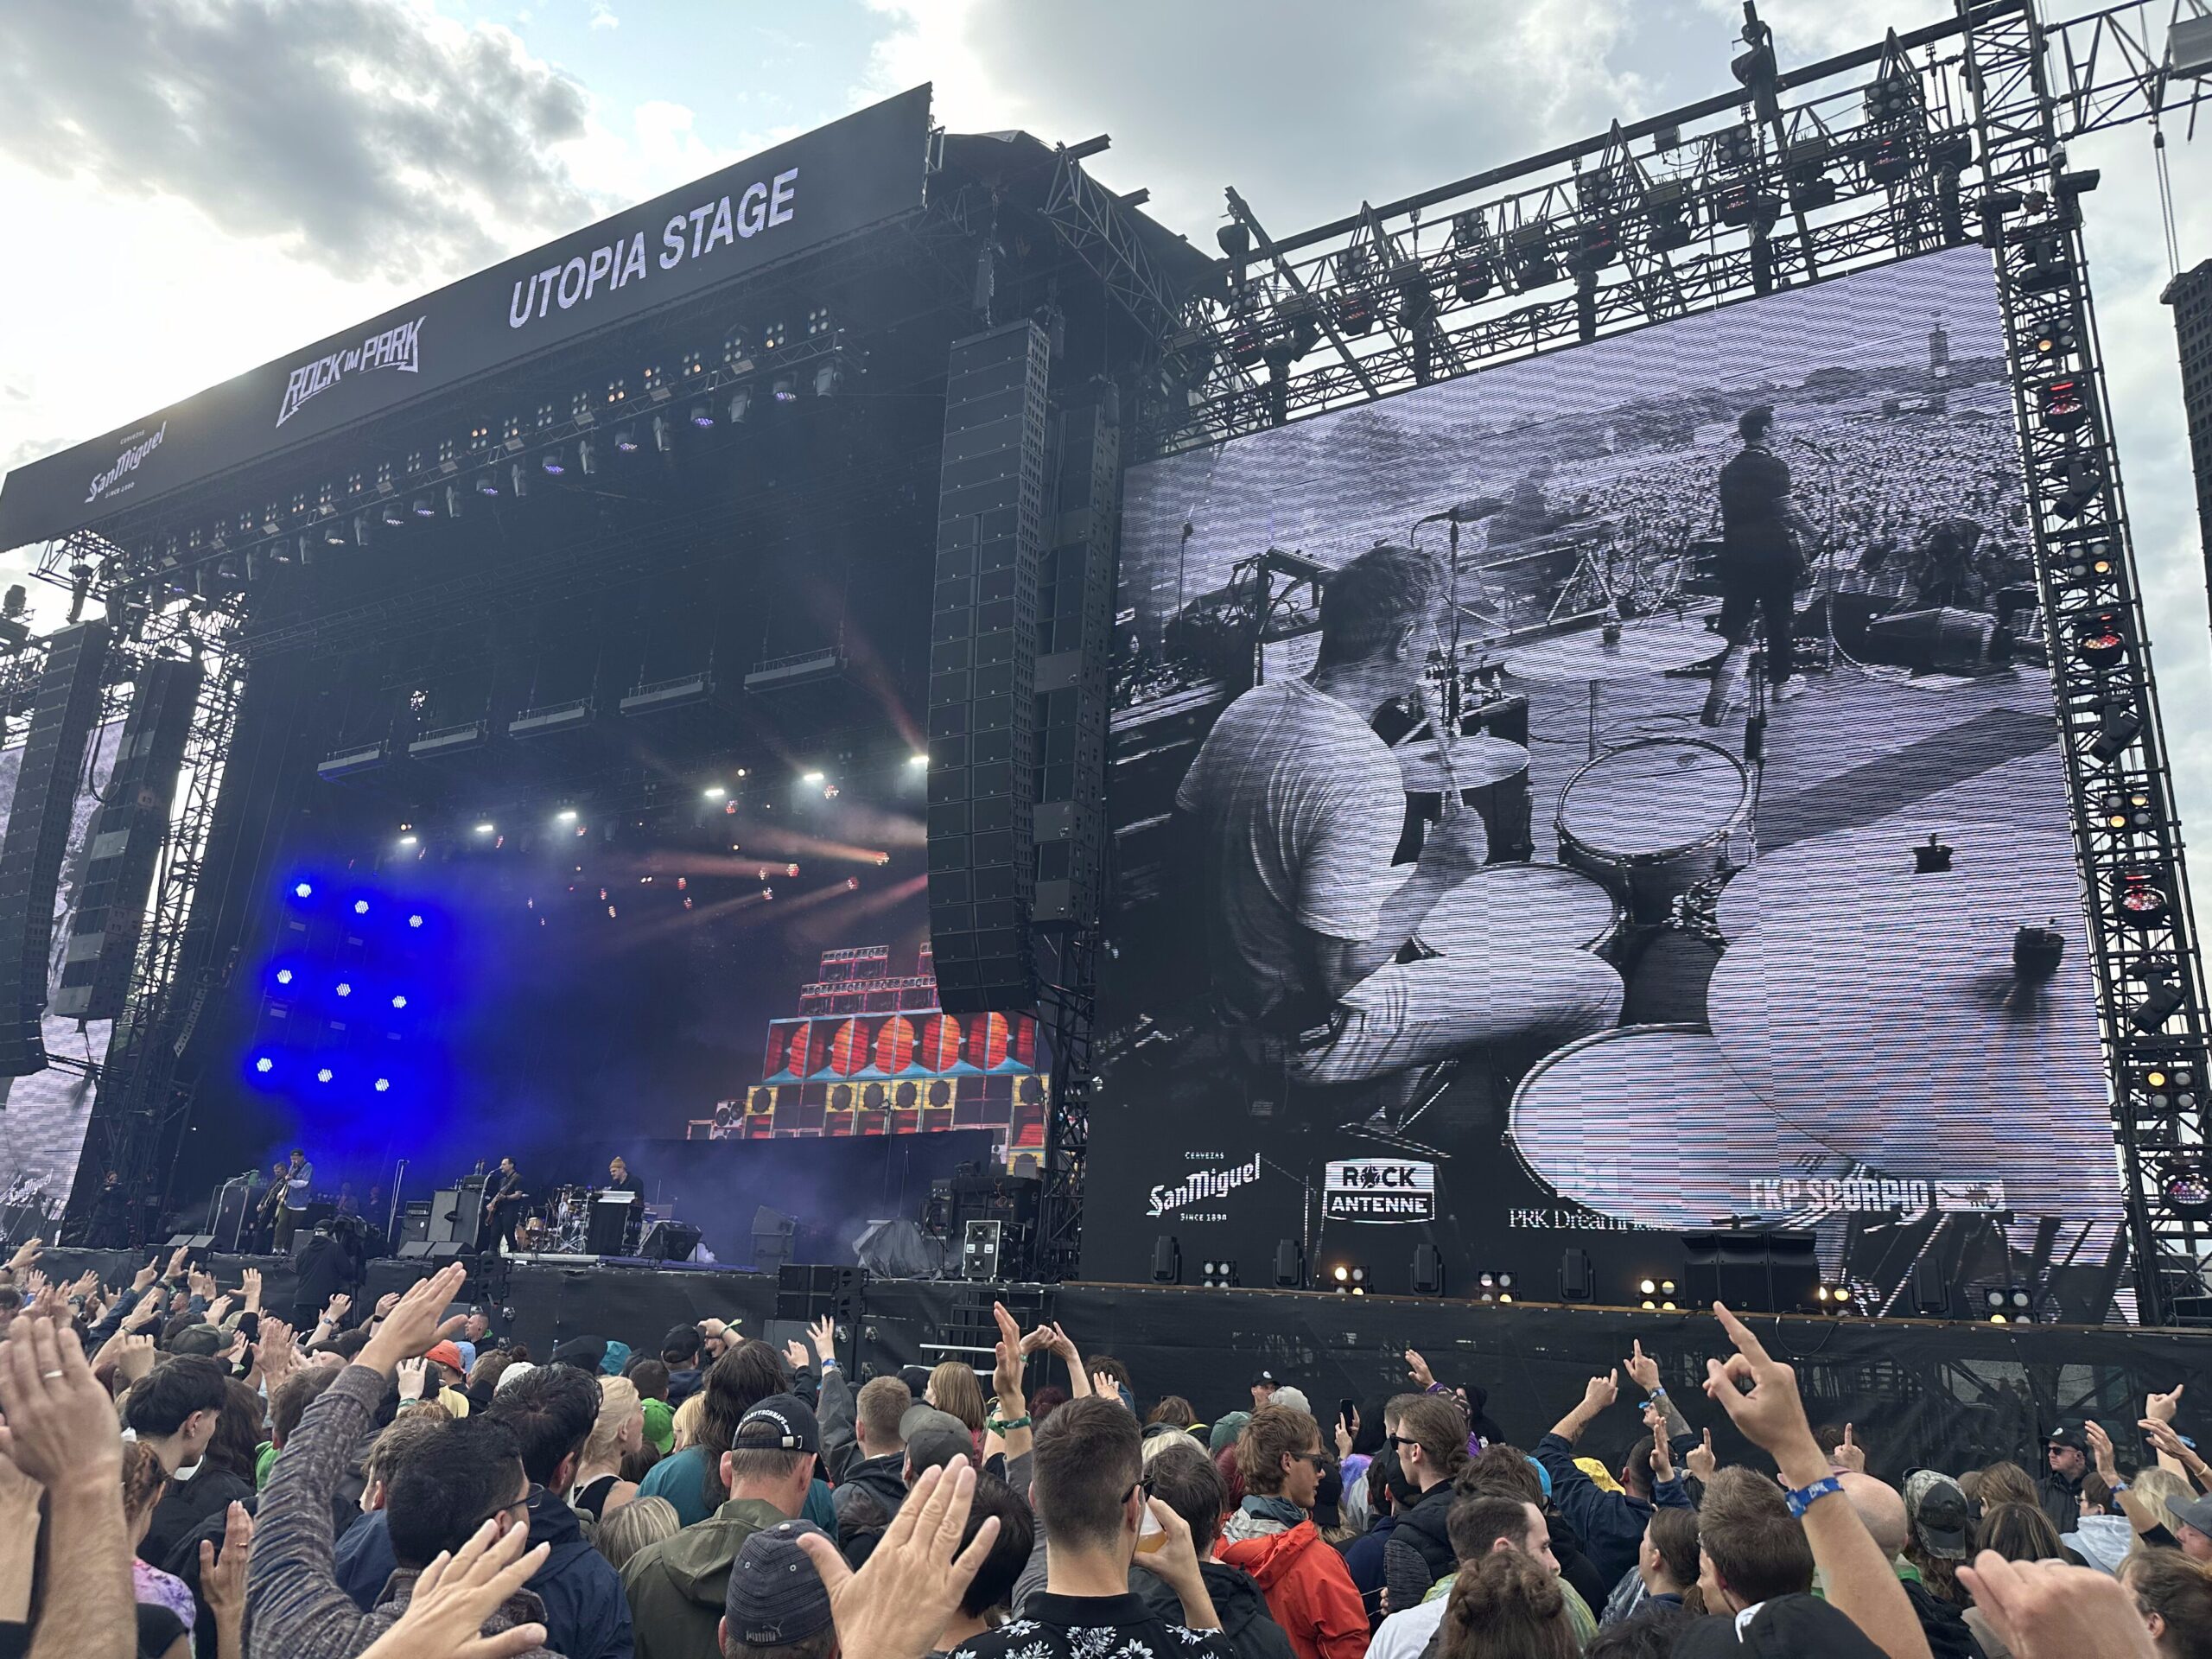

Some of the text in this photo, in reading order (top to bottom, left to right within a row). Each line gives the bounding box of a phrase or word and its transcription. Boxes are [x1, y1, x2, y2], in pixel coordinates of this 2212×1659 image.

[509, 167, 798, 328] UTOPIA STAGE
[276, 350, 346, 429] ROCK
[359, 315, 427, 373] PARK
[1331, 1196, 1427, 1213] ANTENNE
[1509, 1209, 1550, 1228] PRK
